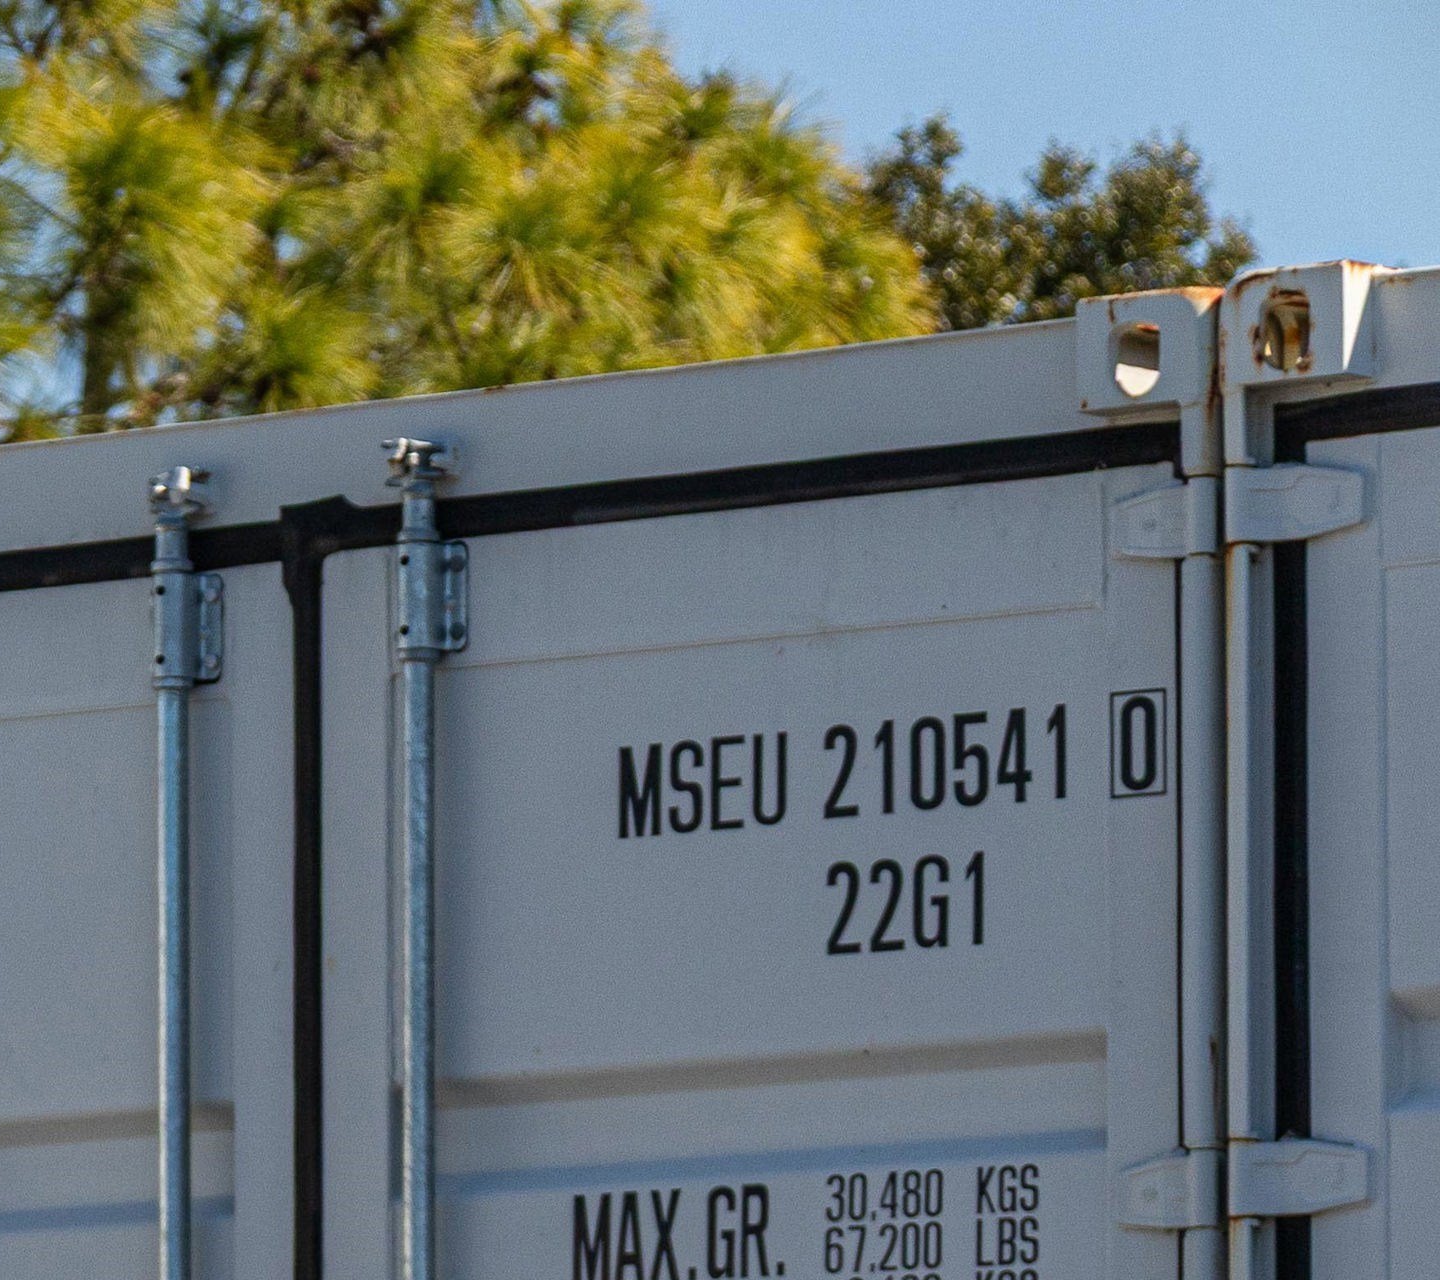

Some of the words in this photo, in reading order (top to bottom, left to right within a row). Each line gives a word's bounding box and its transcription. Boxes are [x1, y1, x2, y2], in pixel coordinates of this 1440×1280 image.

[617, 731, 788, 839] MSEU
[822, 703, 1068, 819] 210541
[1116, 692, 1160, 794] 0
[825, 850, 986, 956] 22G1
[975, 1163, 1039, 1214] KGS
[975, 1215, 1039, 1267] LBS
